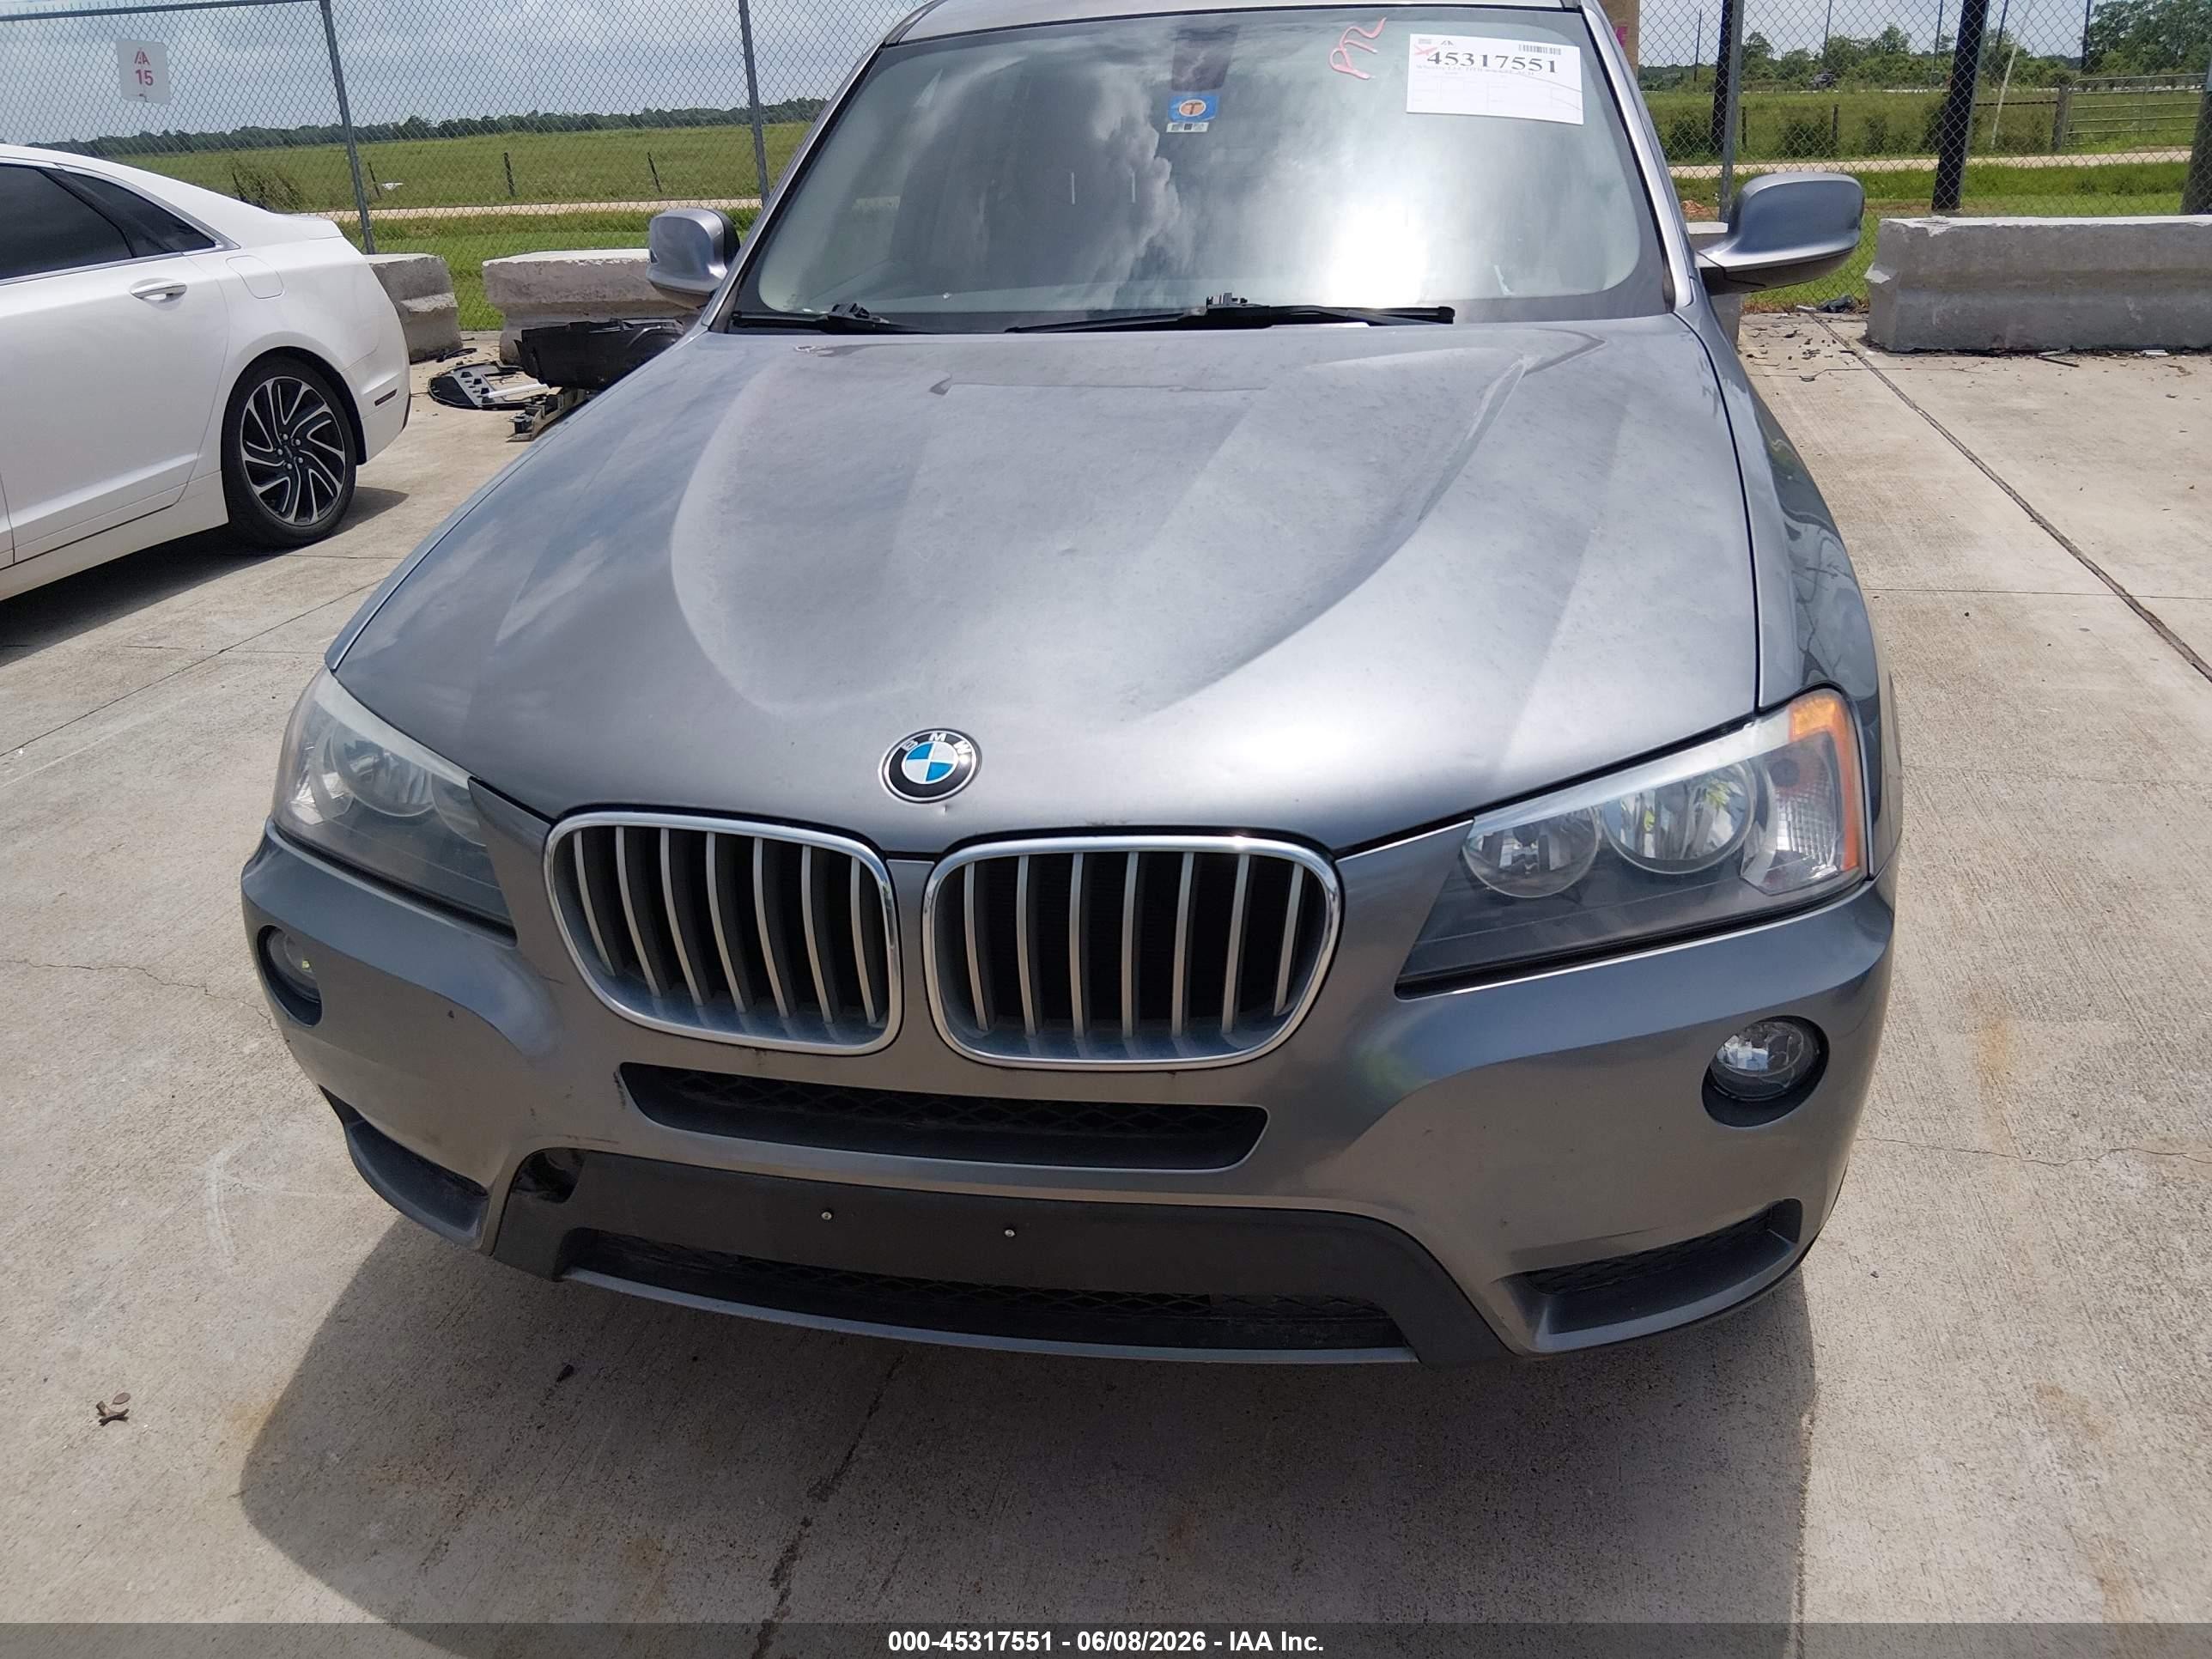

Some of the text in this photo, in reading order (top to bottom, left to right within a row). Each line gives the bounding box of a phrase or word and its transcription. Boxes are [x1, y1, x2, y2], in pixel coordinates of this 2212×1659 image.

[1427, 52, 1556, 74] 45317551
[136, 69, 154, 86] 15
[901, 732, 972, 756] BMW
